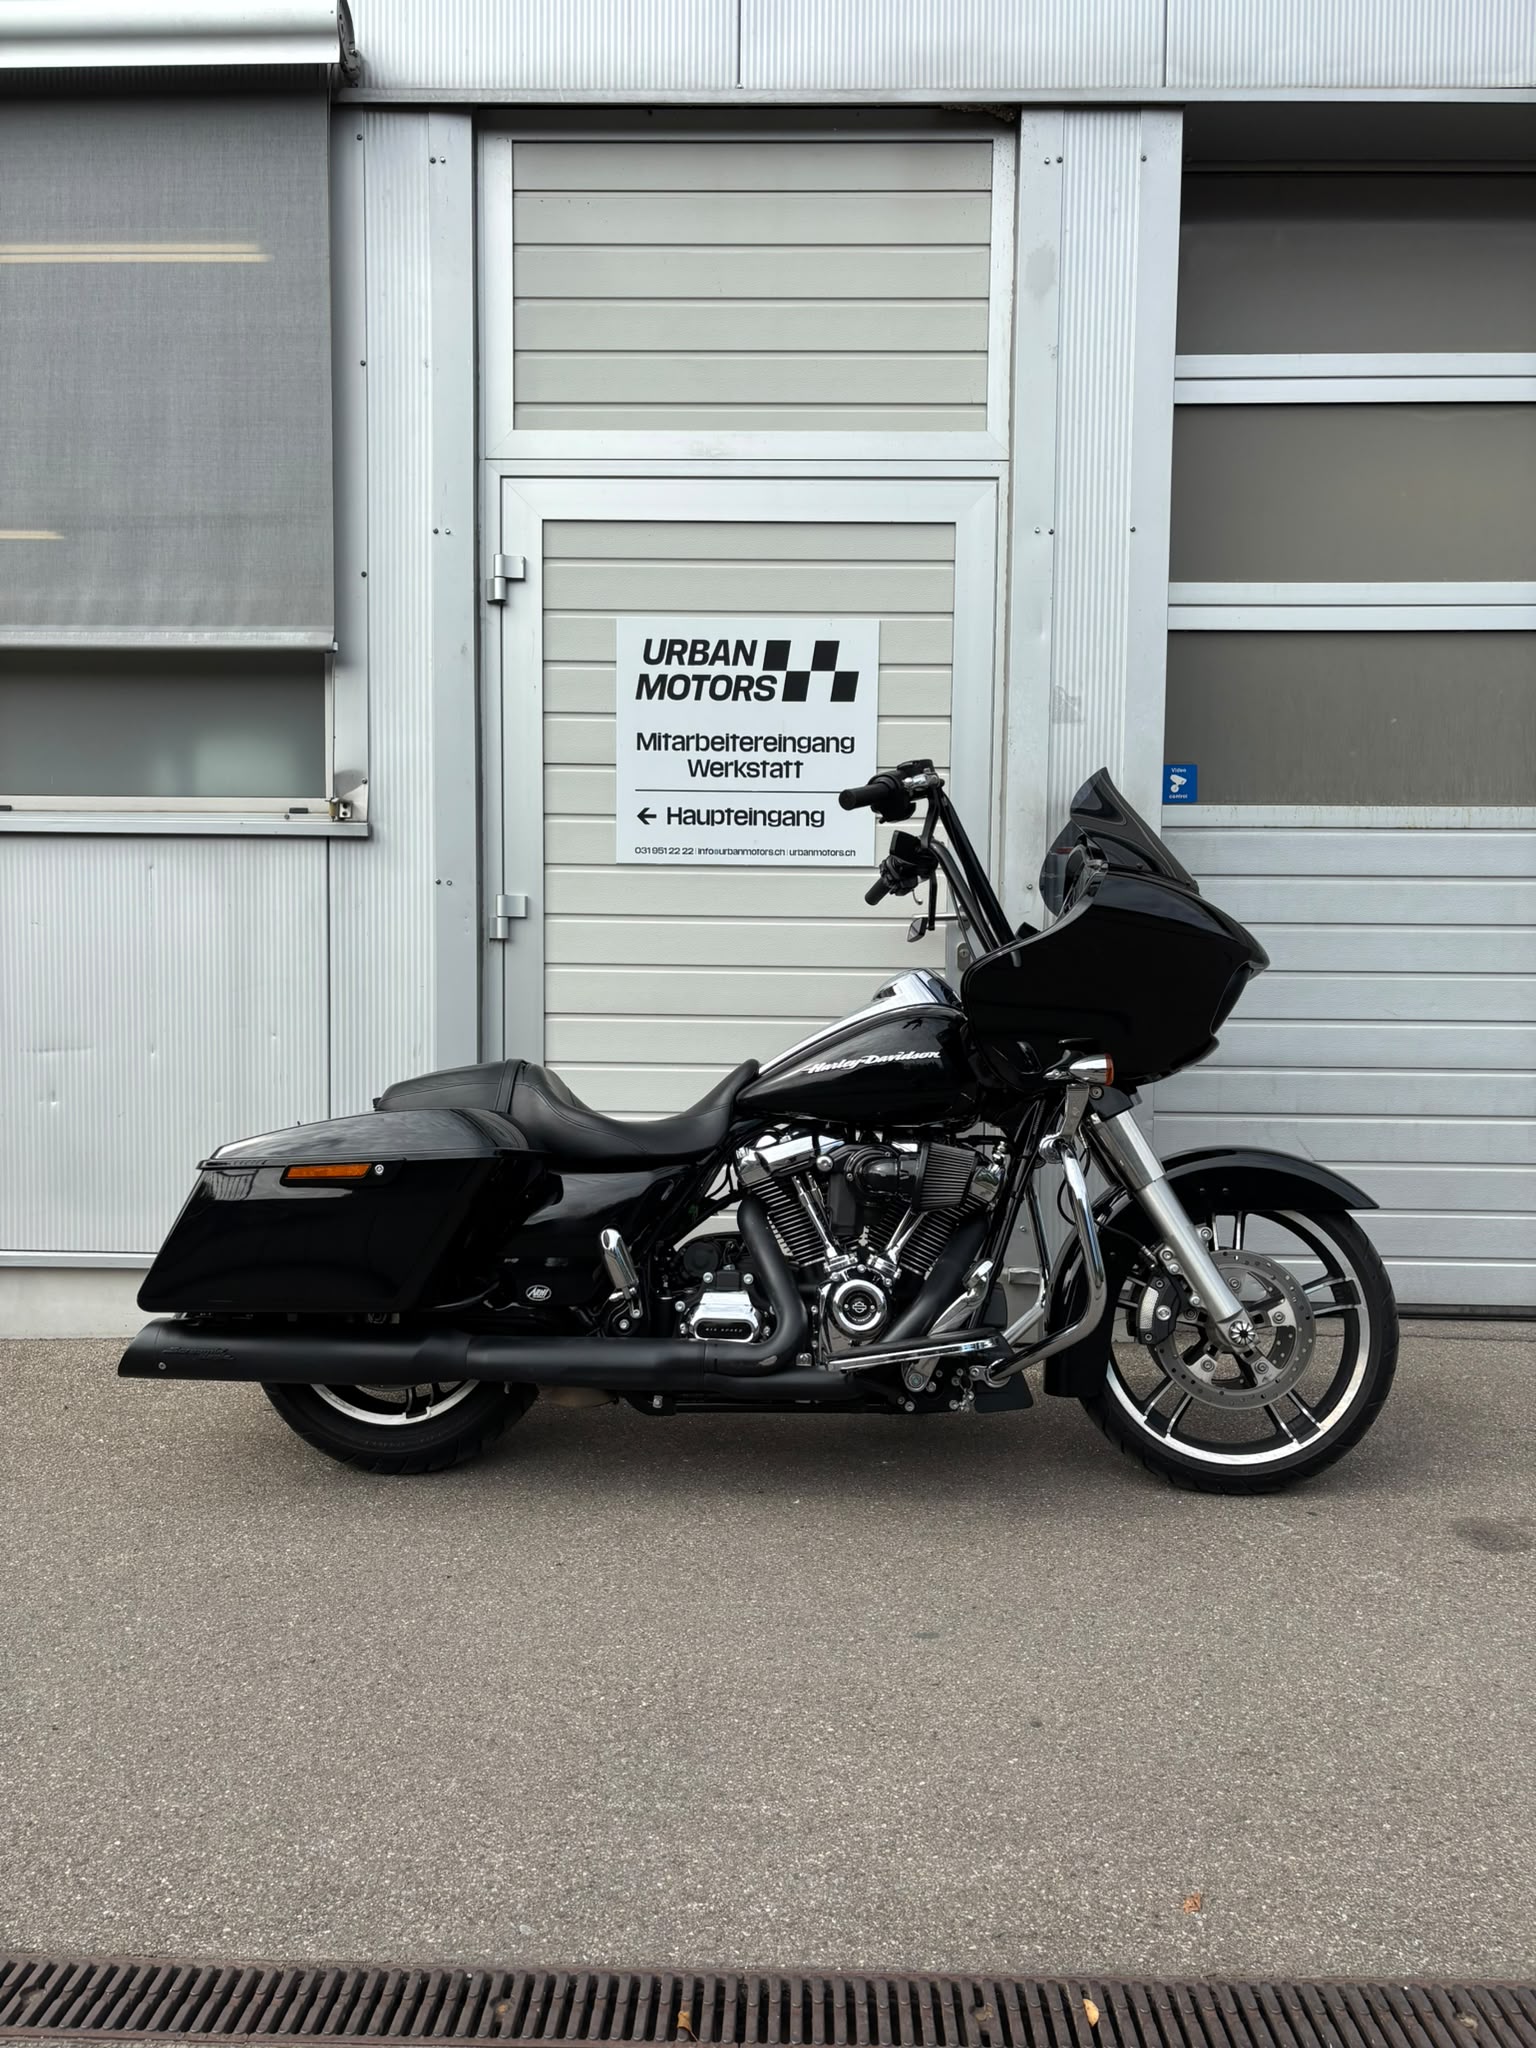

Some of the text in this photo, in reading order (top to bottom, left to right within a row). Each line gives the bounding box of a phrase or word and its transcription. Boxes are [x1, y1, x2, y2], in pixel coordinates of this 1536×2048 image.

[642, 638, 758, 666] URBAN
[635, 673, 778, 702] MOTORS
[636, 732, 855, 754] Mitarbeitereingang
[687, 759, 804, 779] Werkstatt
[666, 806, 825, 827] Haupteingang
[668, 847, 681, 855] 22
[681, 847, 694, 855] 22
[789, 848, 856, 857] urbanmotors.ch
[802, 1051, 941, 1073] Harley-Davidson
